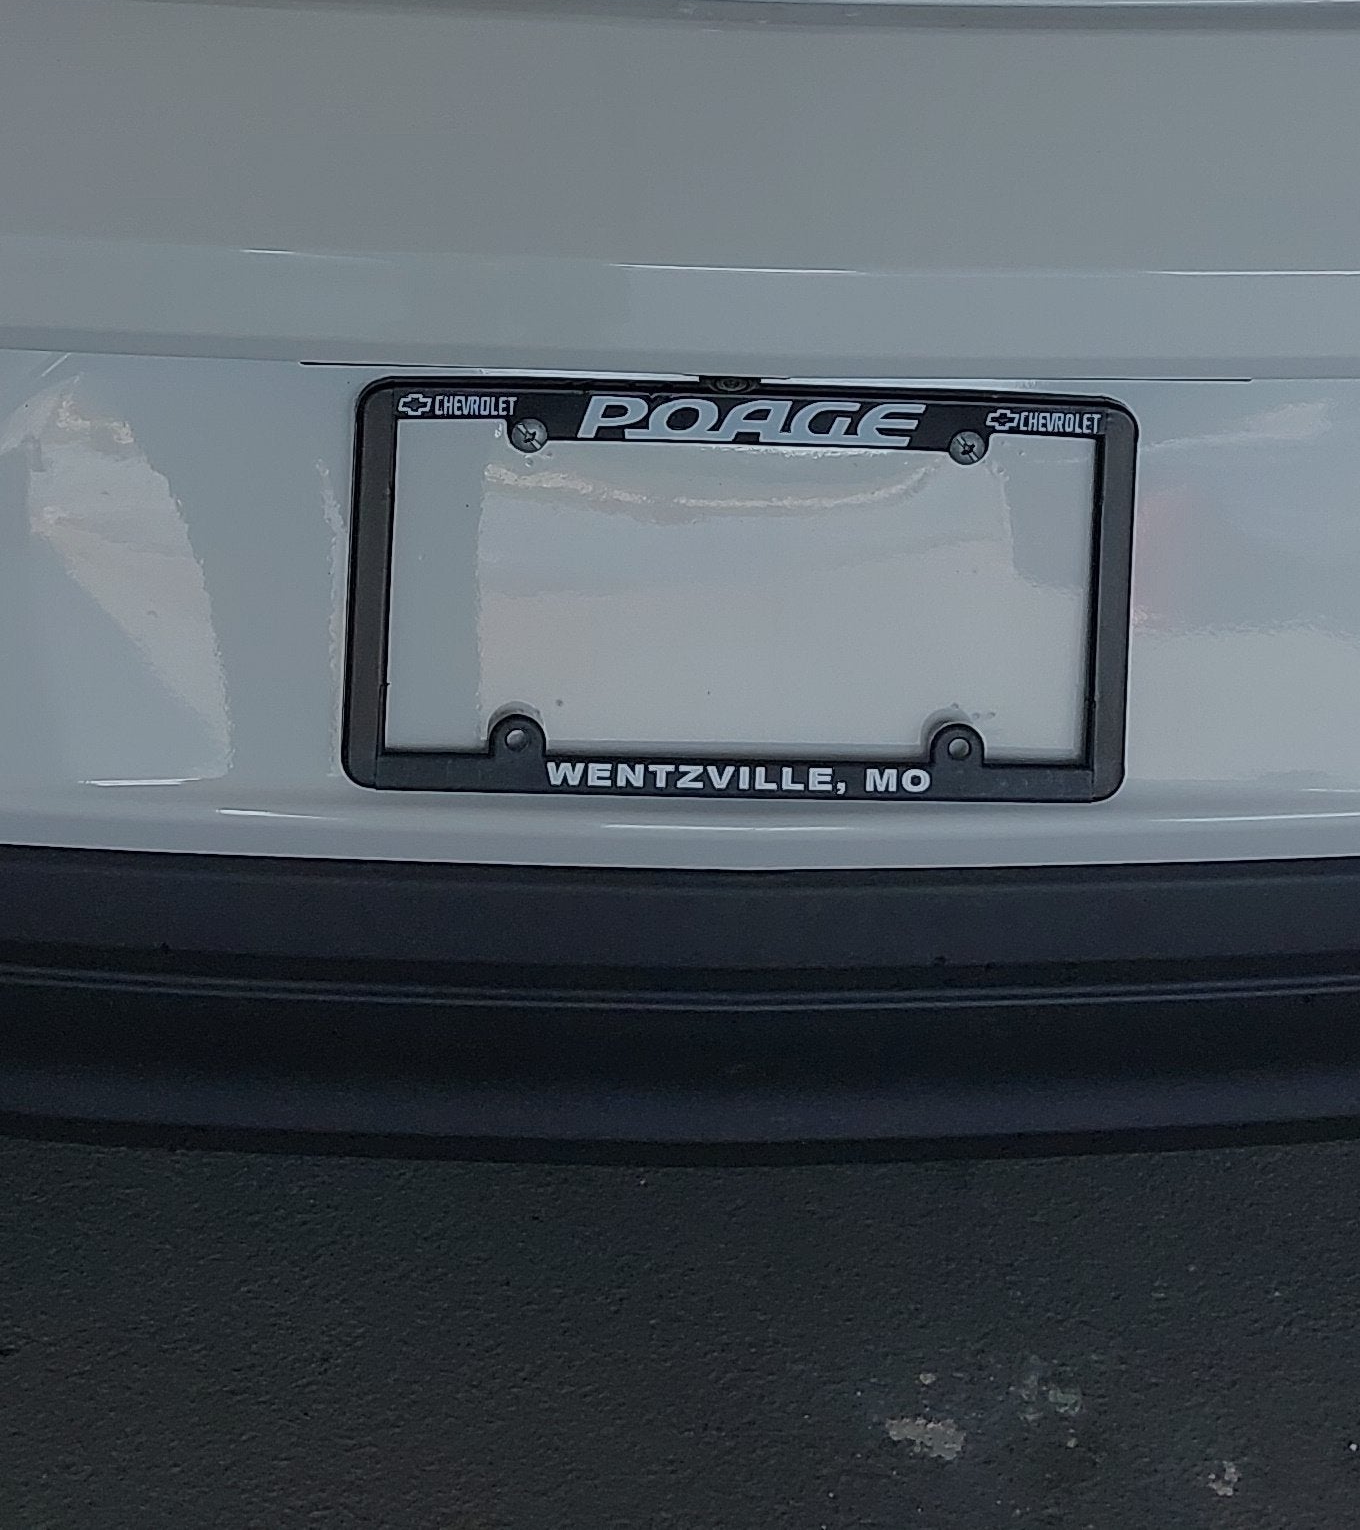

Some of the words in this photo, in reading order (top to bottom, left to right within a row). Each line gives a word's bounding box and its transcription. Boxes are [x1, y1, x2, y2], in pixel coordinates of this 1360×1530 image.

[434, 394, 518, 416] CHEVROLET
[576, 395, 927, 447] POAGE
[1019, 411, 1102, 434] CHEVROLET
[545, 761, 846, 795] WENTZVILLE,
[864, 768, 931, 793] MO
